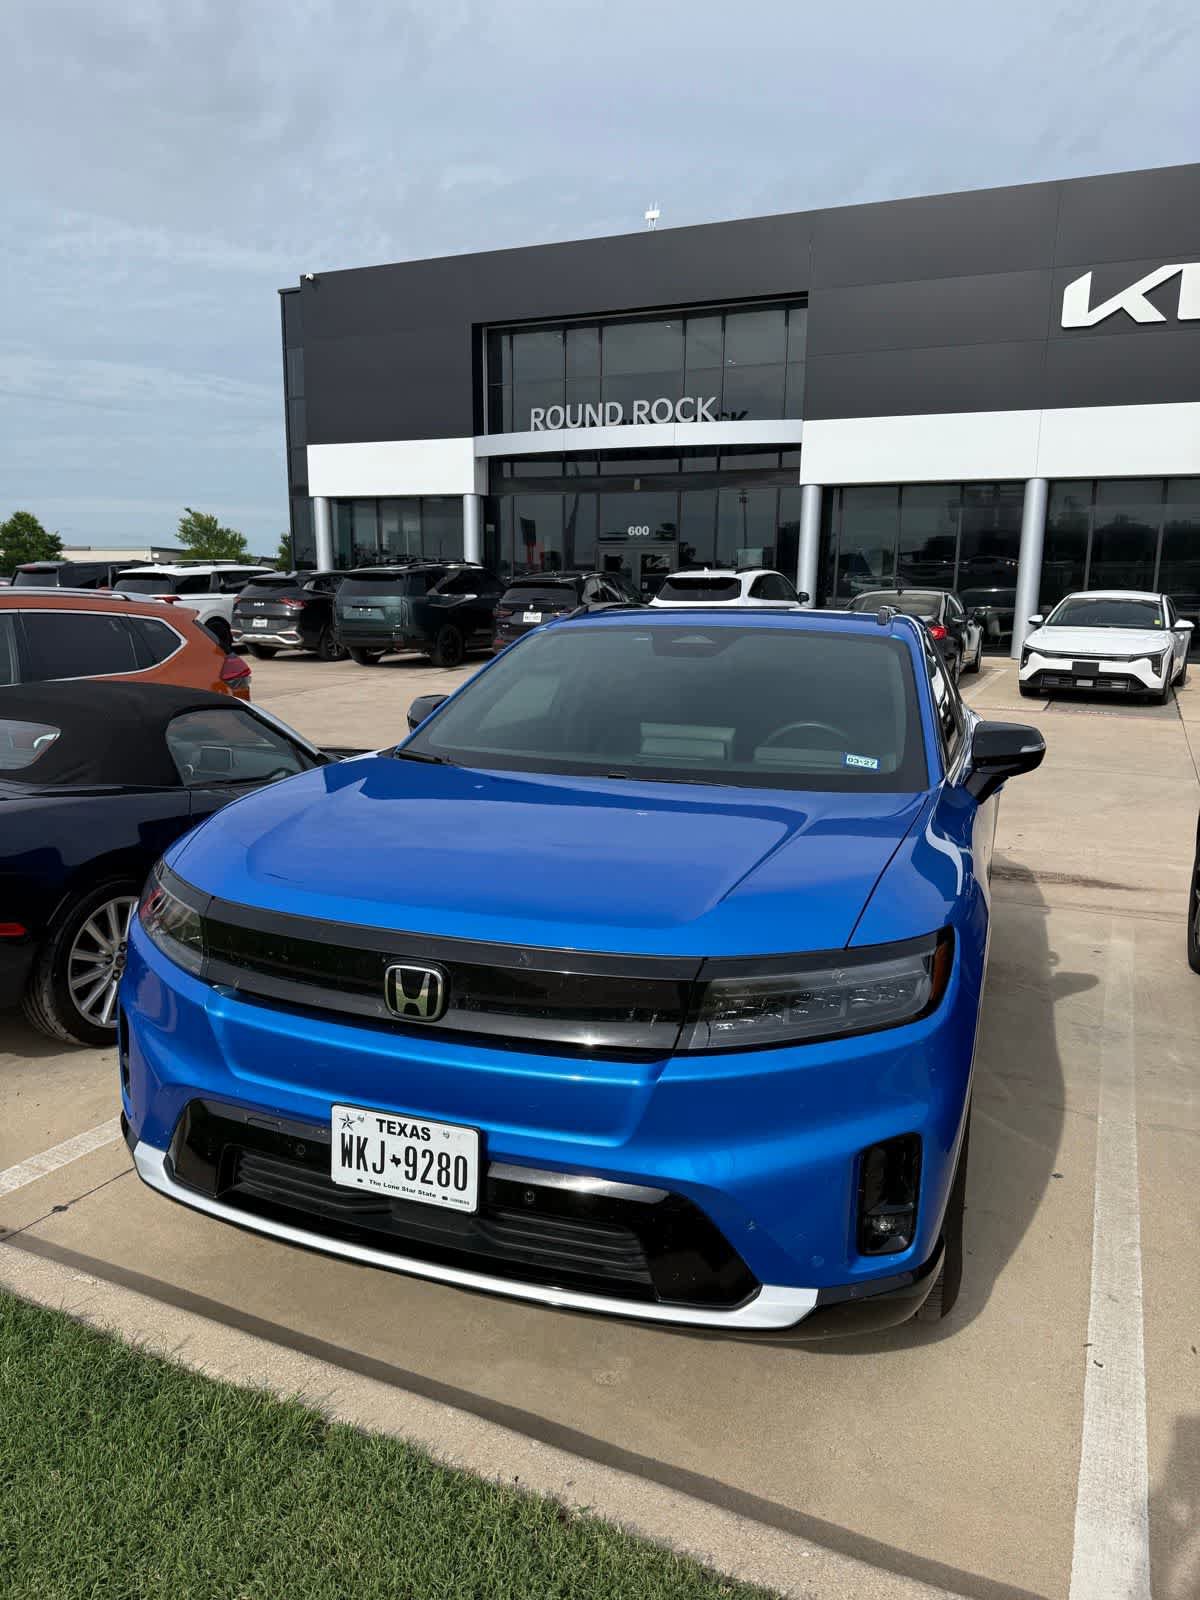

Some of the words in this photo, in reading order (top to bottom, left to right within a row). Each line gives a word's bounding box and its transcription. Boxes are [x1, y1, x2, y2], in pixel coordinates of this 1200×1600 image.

[1061, 262, 1200, 328] KI
[530, 401, 624, 431] ROUND
[633, 396, 717, 425] ROCK
[627, 525, 650, 536] 600
[375, 1117, 431, 1142] TEXAS
[340, 1132, 386, 1175] WKJ
[404, 1145, 468, 1192] 9280
[369, 1179, 381, 1187] The
[383, 1182, 400, 1191] Lone
[401, 1186, 416, 1194] Star
[417, 1189, 437, 1199] State
